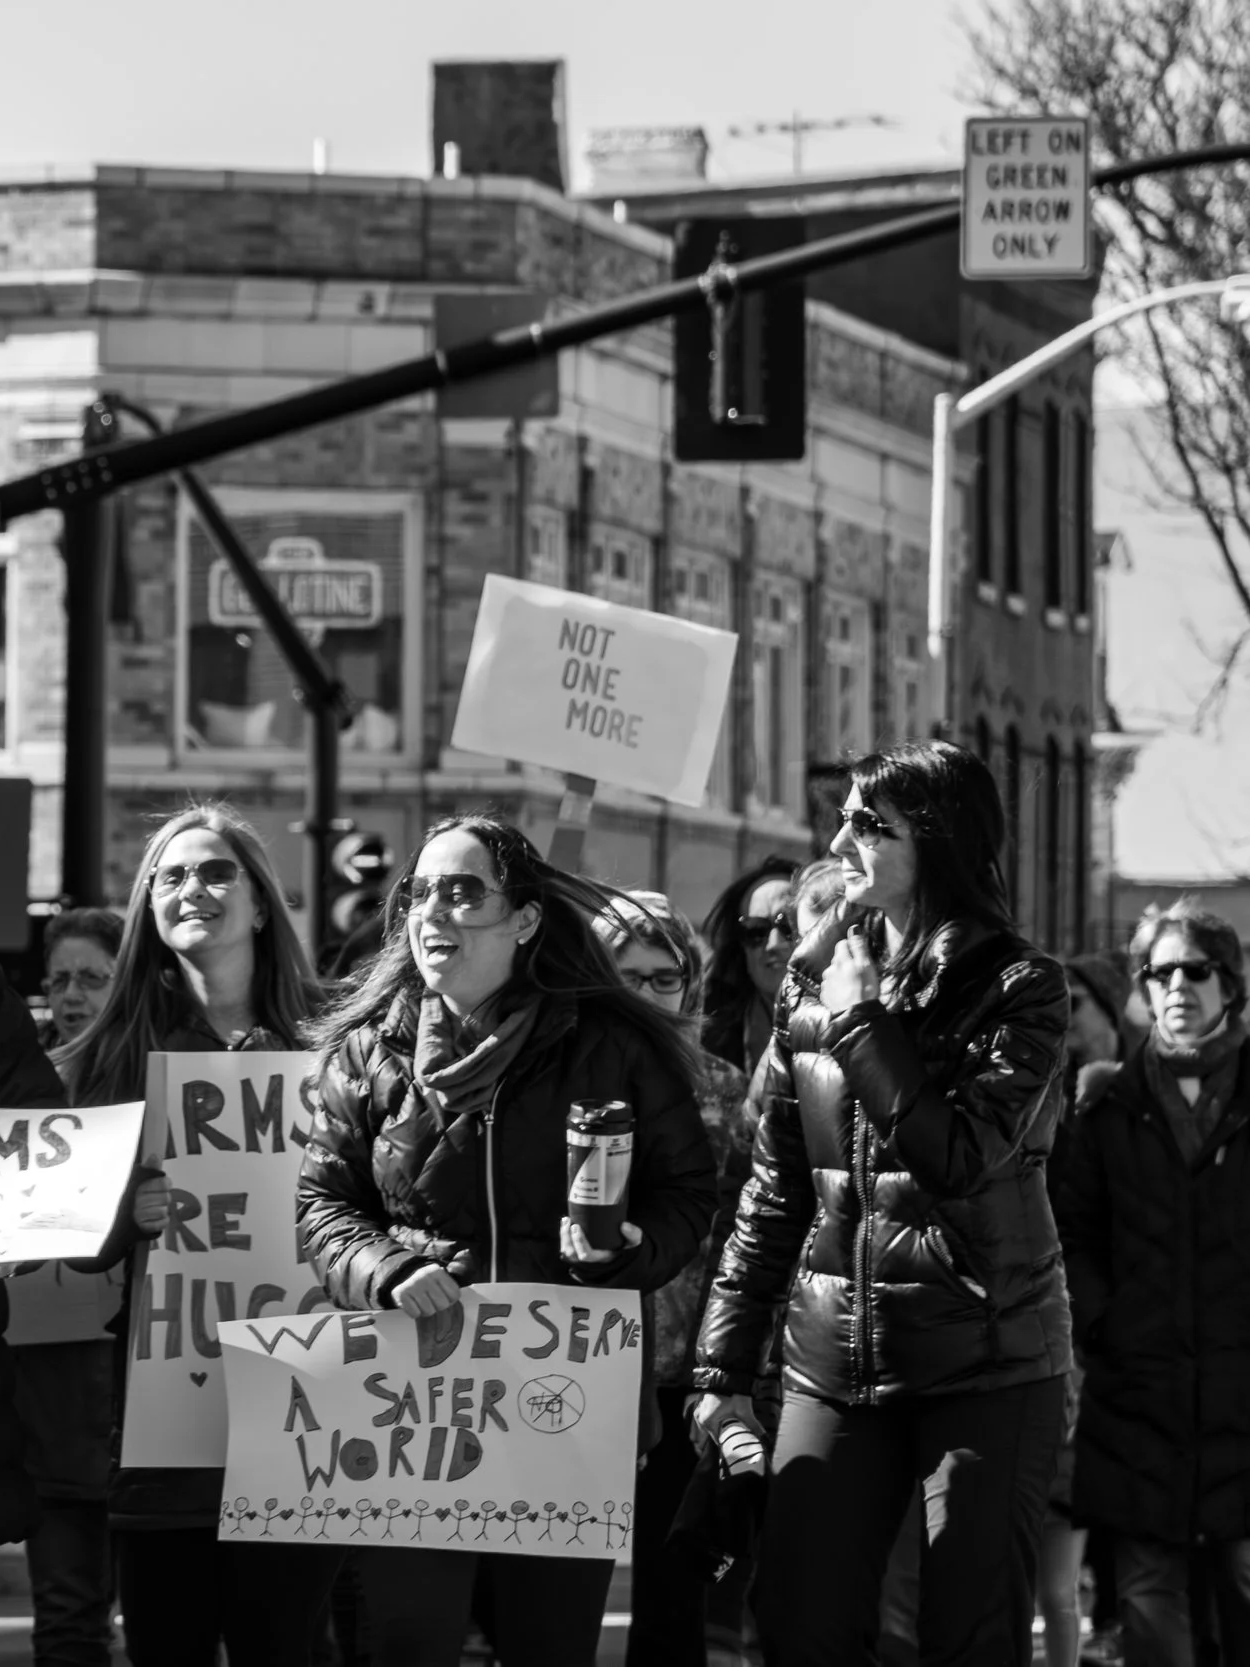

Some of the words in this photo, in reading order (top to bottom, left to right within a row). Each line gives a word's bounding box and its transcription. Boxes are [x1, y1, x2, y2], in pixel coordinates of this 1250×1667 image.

[971, 128, 1031, 156] LEFT
[1048, 128, 1081, 155] ON
[986, 163, 1067, 190] GREEN
[982, 198, 1071, 225] ARROW
[992, 232, 1061, 260] ONLY
[559, 618, 615, 660] NOT
[562, 658, 620, 701] ONE
[566, 698, 643, 749] MORE
[150, 1187, 252, 1254] RE
[246, 1312, 378, 1365] WE
[415, 1299, 641, 1369] DESERVE
[283, 1375, 323, 1432] A
[363, 1372, 509, 1433] SAFER
